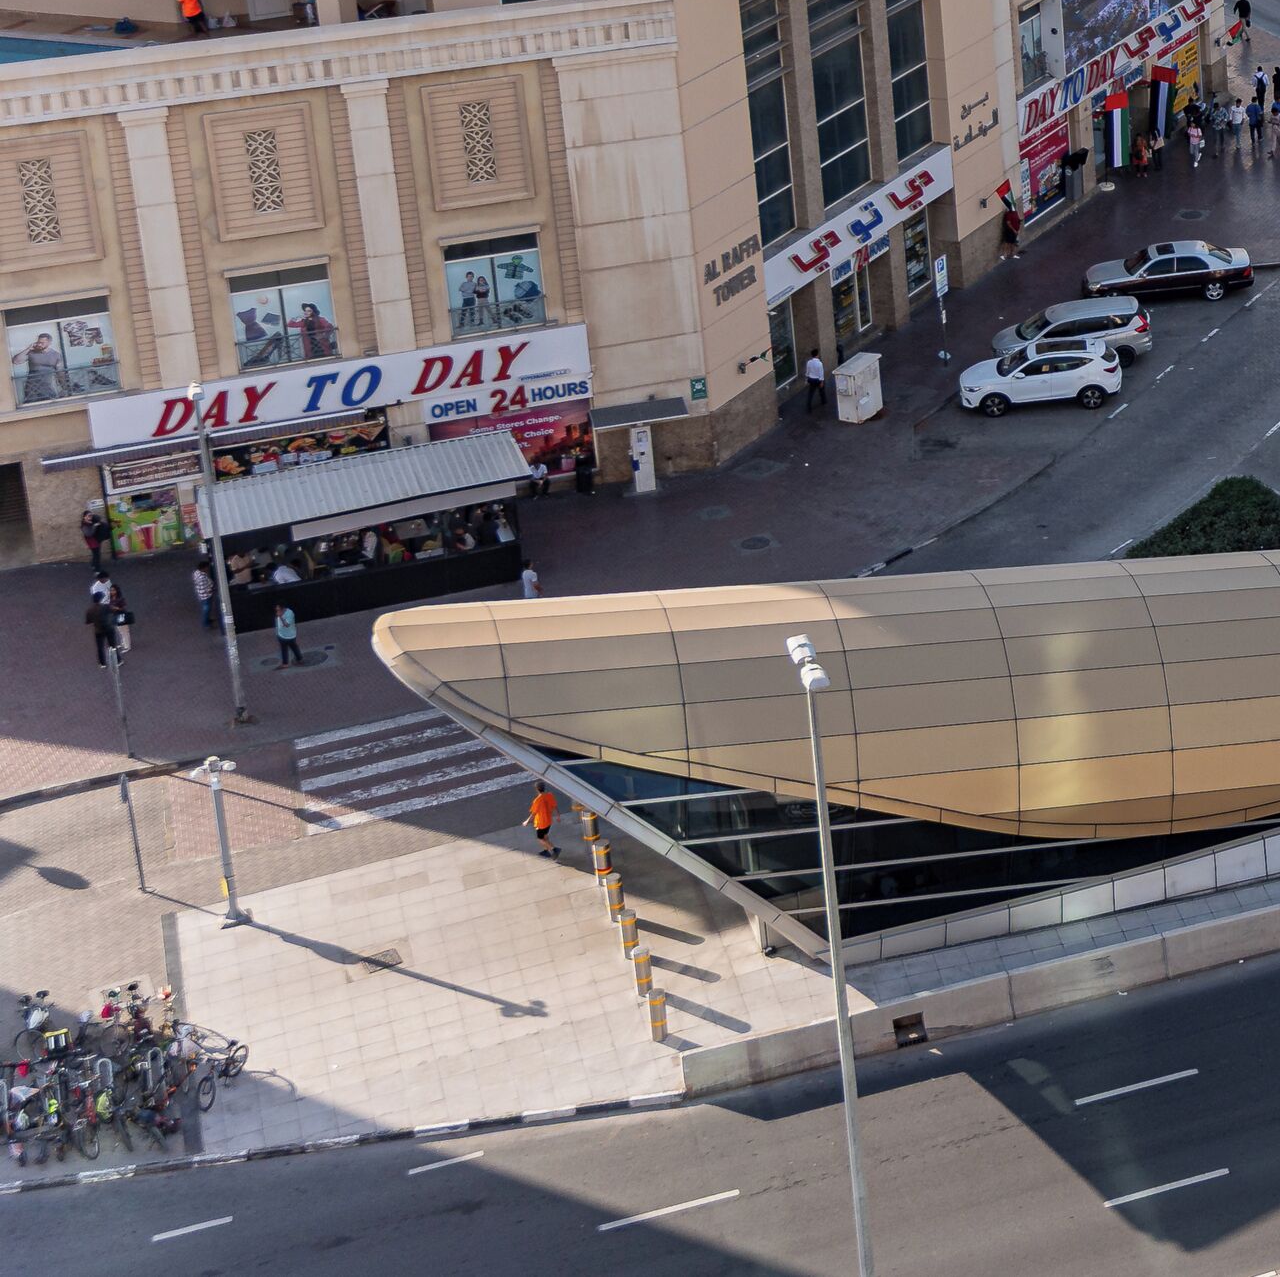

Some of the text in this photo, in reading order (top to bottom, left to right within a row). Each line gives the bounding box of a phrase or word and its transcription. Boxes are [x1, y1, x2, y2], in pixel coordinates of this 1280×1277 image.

[1022, 44, 1122, 135] DAY TO DAY
[704, 234, 761, 285] AL RAFFA
[712, 264, 758, 307] TOWER
[152, 341, 530, 437] DAY TO DAY
[431, 380, 589, 418] OPEN 24 HOURS
[468, 414, 562, 434] Some Stores Change.
[524, 428, 555, 438] Choice
